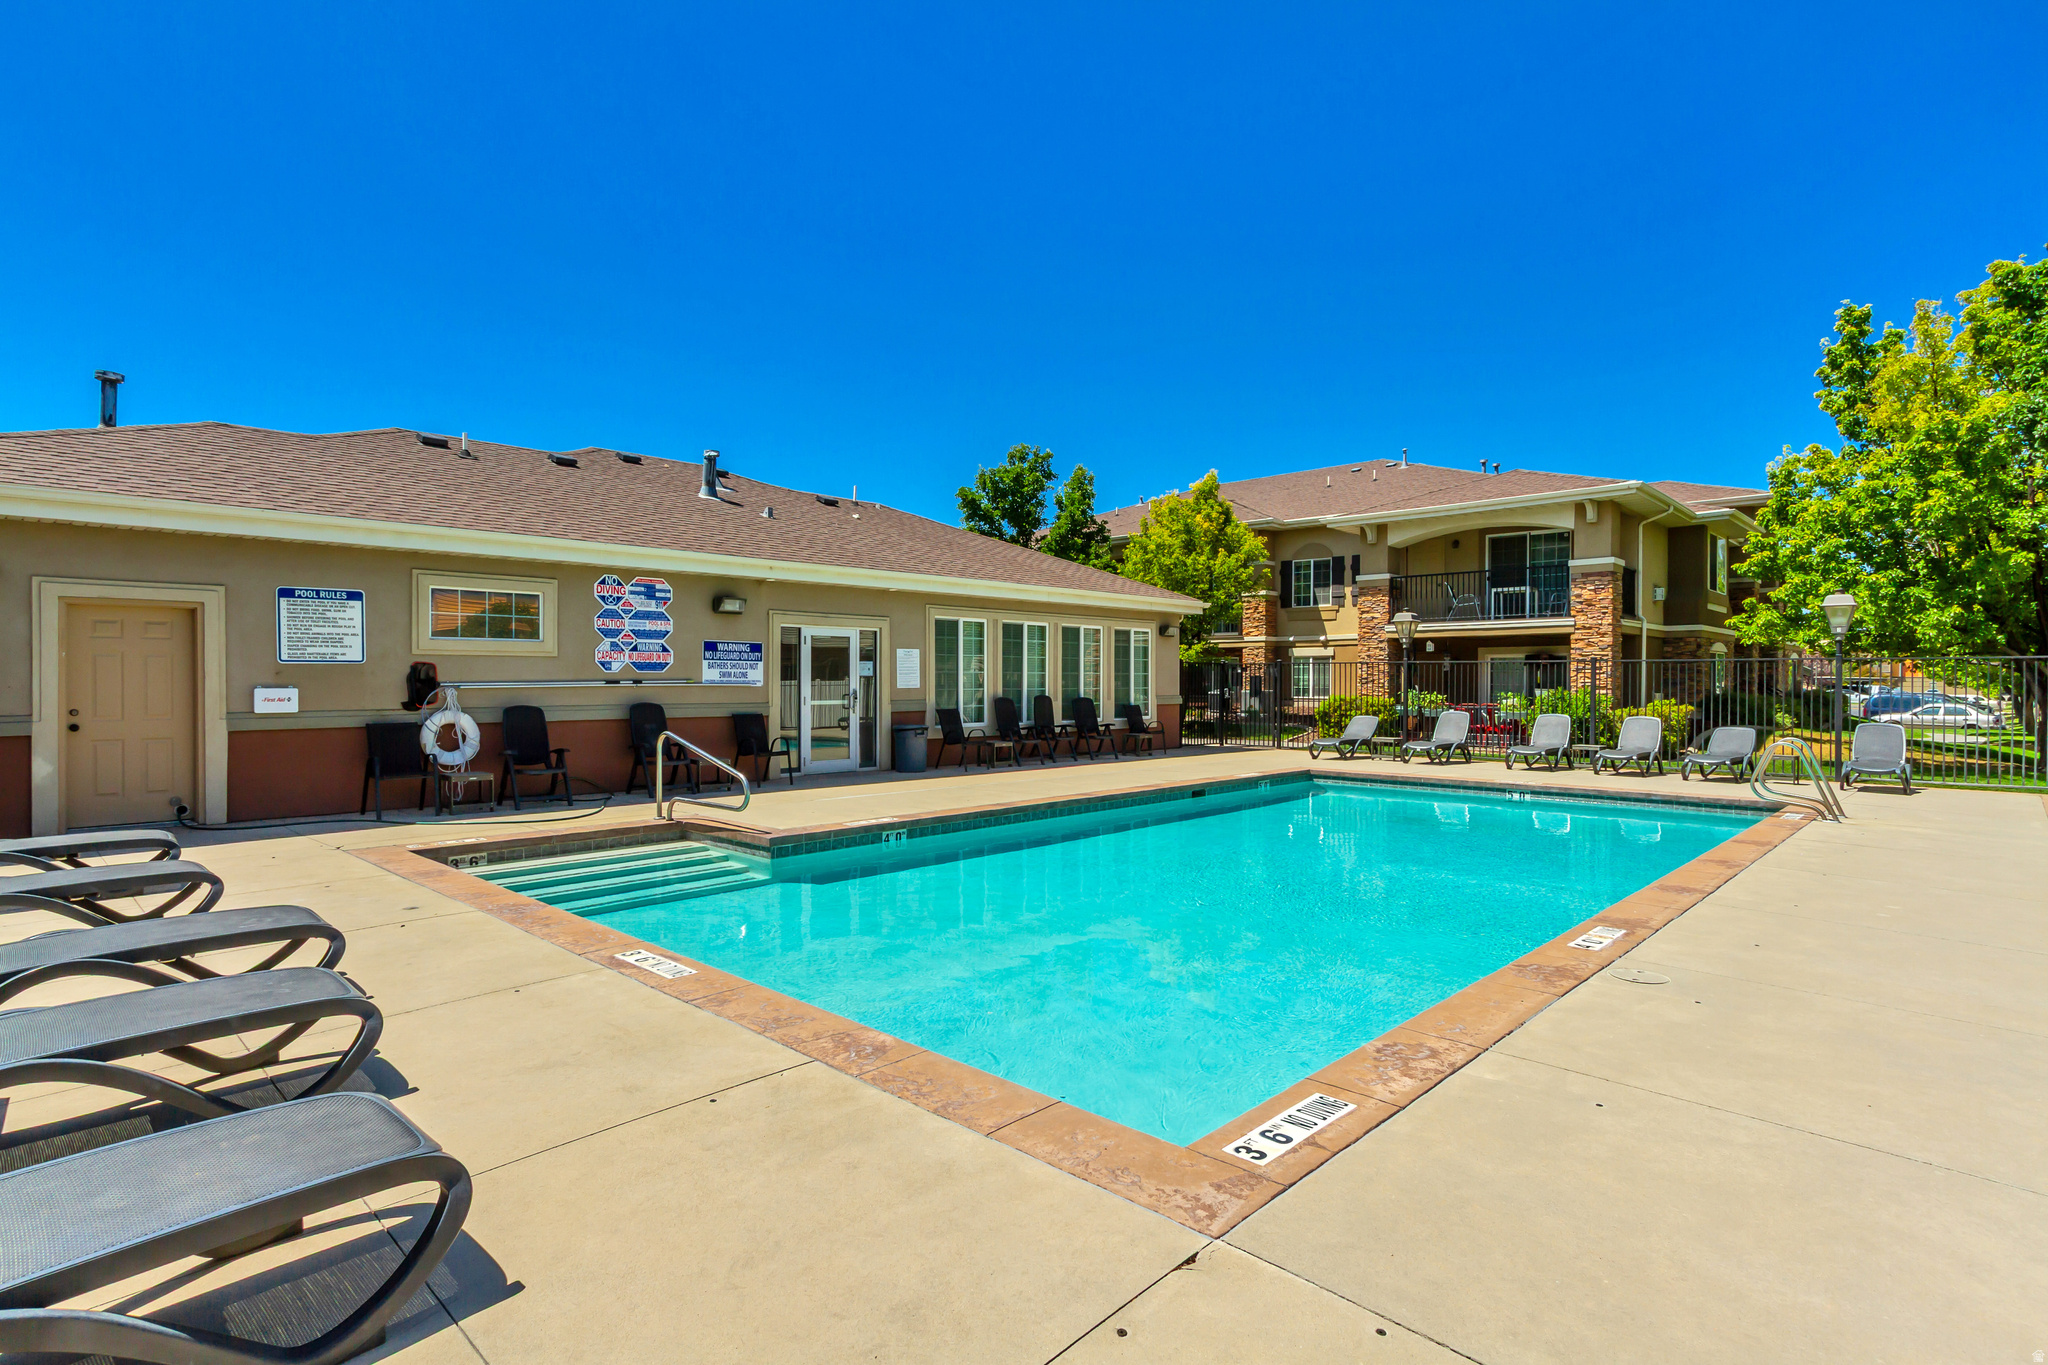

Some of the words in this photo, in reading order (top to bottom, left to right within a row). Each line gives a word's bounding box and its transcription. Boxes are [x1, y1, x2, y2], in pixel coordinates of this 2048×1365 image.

[606, 576, 617, 585] NO
[294, 590, 318, 598] POOL
[320, 590, 347, 599] RULES
[596, 584, 626, 595] DIVING
[596, 618, 625, 628] CAUTION
[637, 642, 663, 652] WARNING
[717, 643, 750, 652] WARNING
[597, 651, 626, 660] CAPACITY
[629, 652, 634, 661] NO
[635, 652, 654, 661] LIFEGUARD
[656, 653, 661, 661] ON
[662, 653, 671, 662] DUTY
[705, 651, 713, 659] NO
[714, 652, 740, 660] LIFEGUARD
[1296, 1096, 1349, 1121] DIVING
[1280, 1114, 1318, 1131] NO
